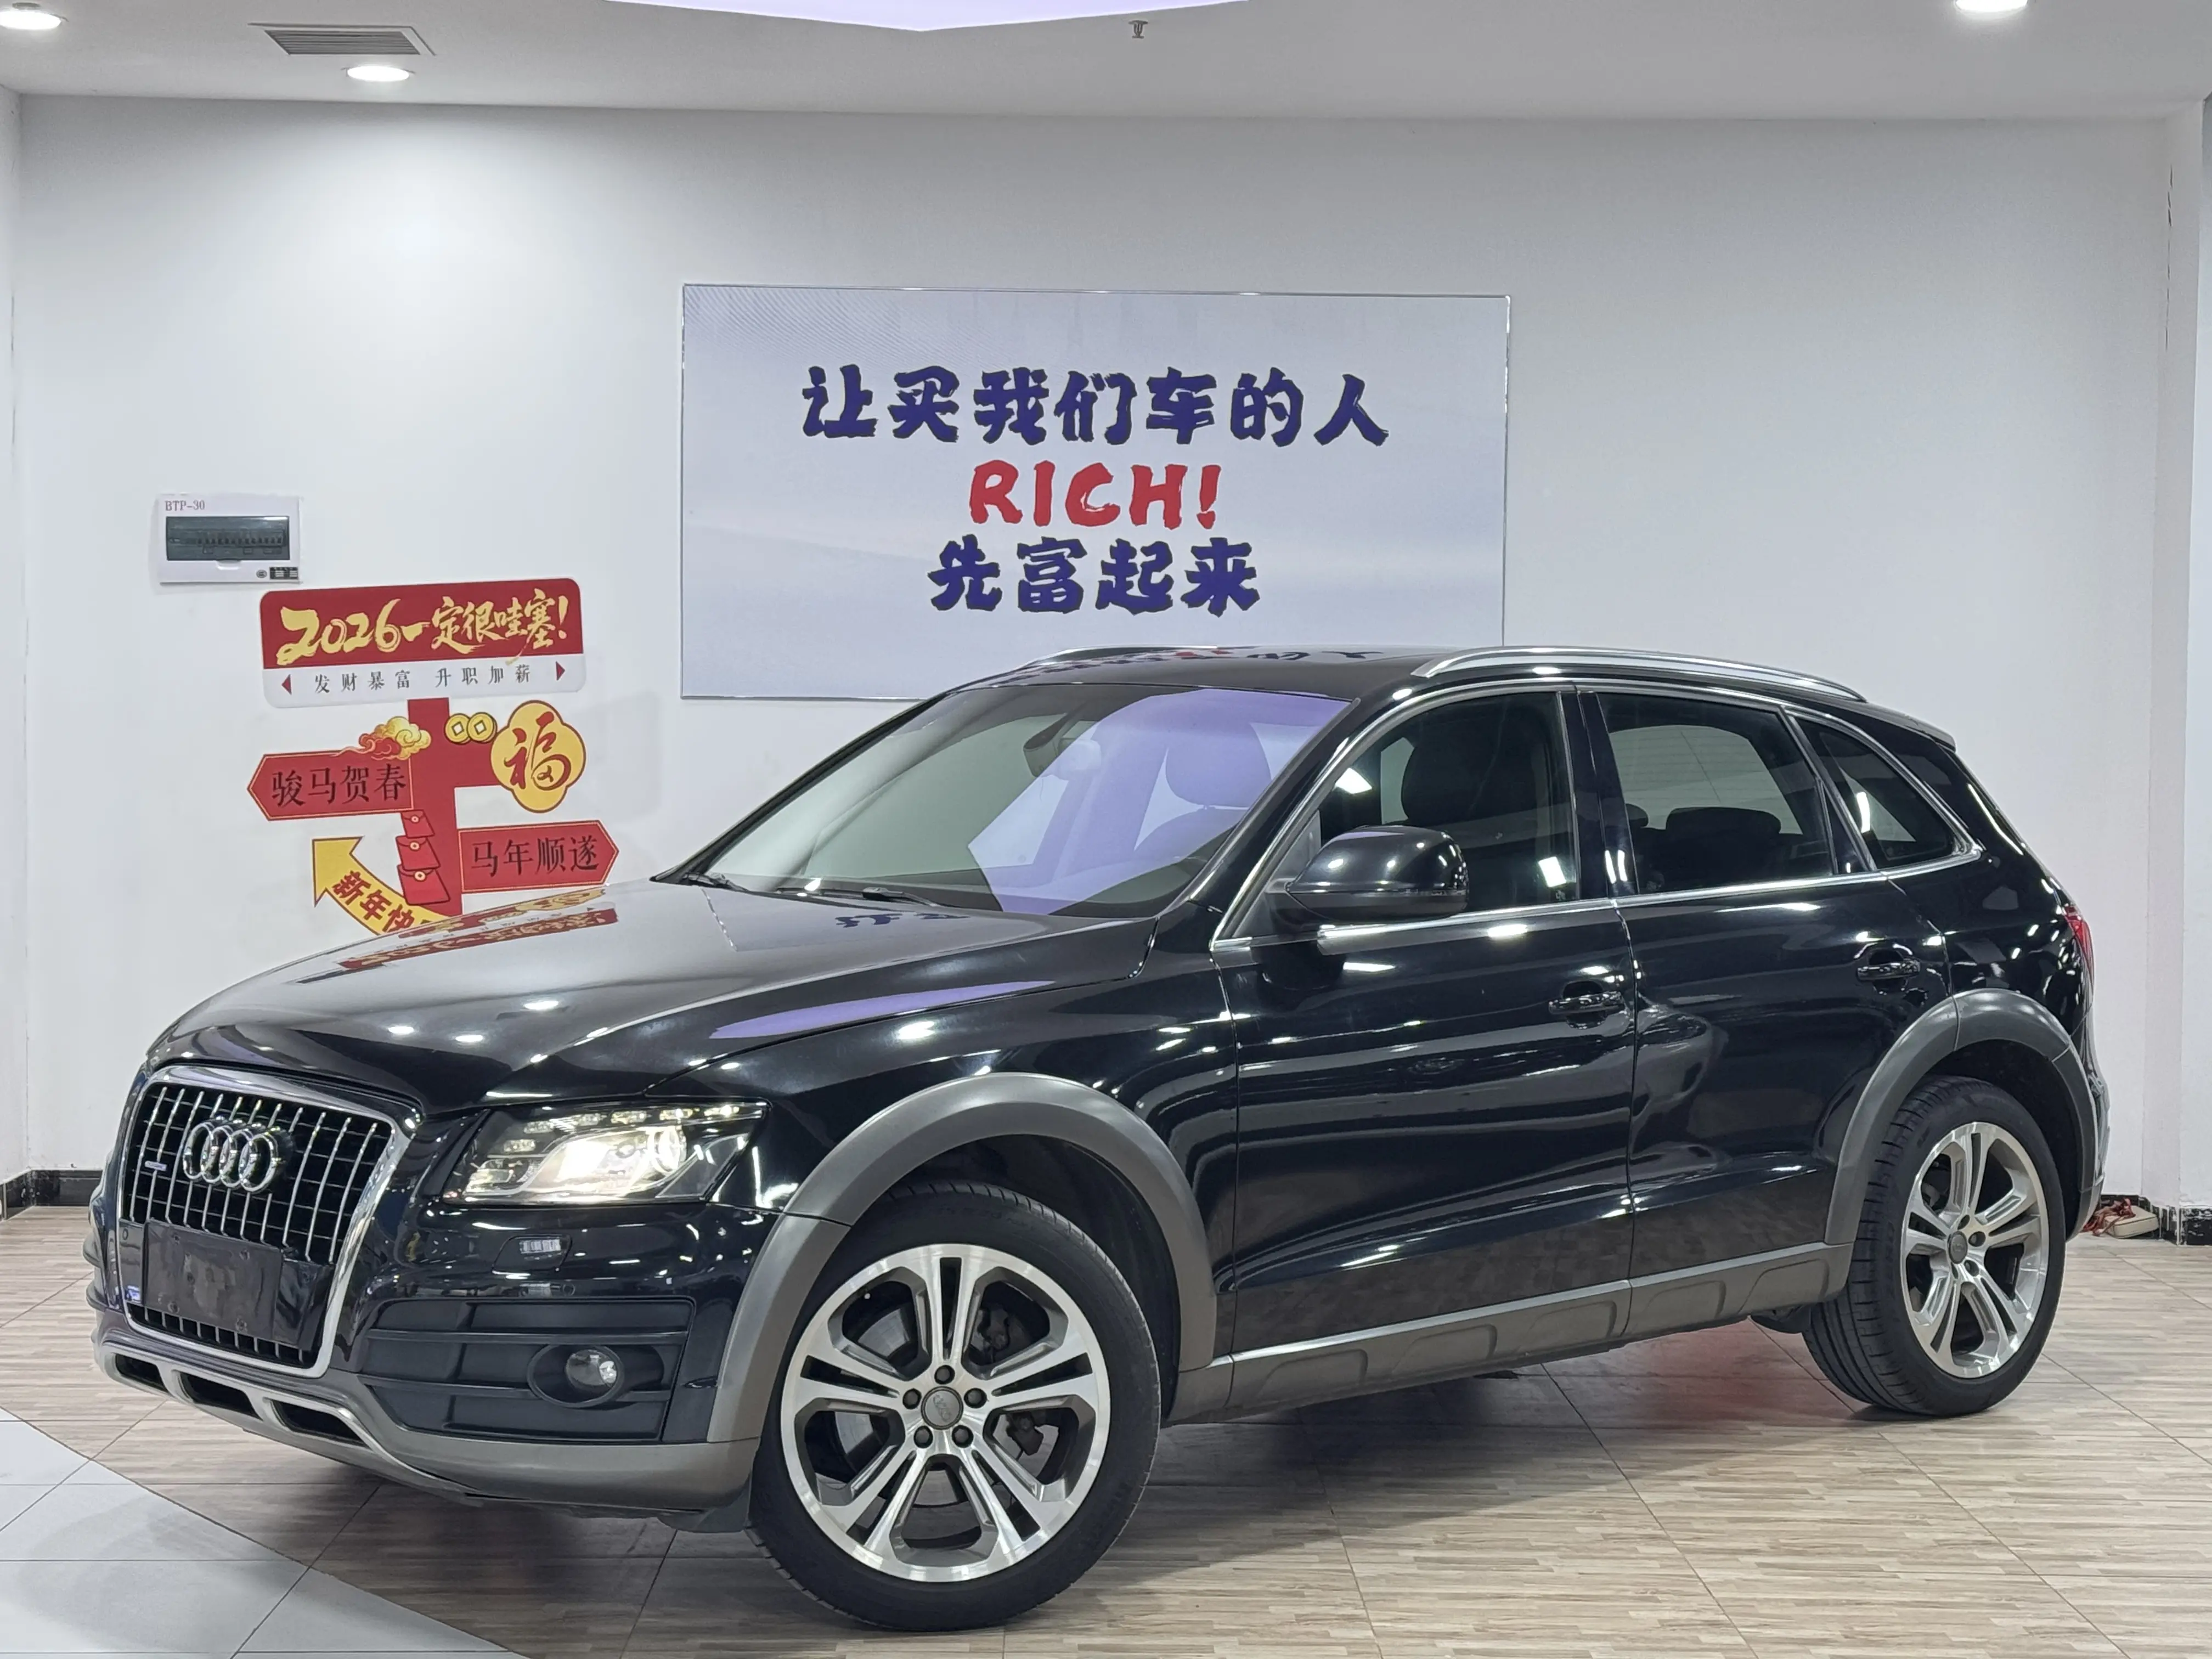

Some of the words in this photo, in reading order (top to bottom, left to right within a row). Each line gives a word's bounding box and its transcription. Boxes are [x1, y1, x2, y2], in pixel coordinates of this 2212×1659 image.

[802, 364, 1389, 447] 让买我们车的人
[165, 500, 205, 511] BTP-30
[969, 460, 1221, 529] RICH!
[927, 534, 1261, 618] 先富起来
[314, 669, 410, 693] 发财暴富
[435, 664, 531, 687] 升职加薪
[504, 712, 572, 790] 福
[272, 763, 407, 807] 骏马贺春
[471, 835, 599, 877] 马年顺遂
[331, 870, 432, 932] 新年快
